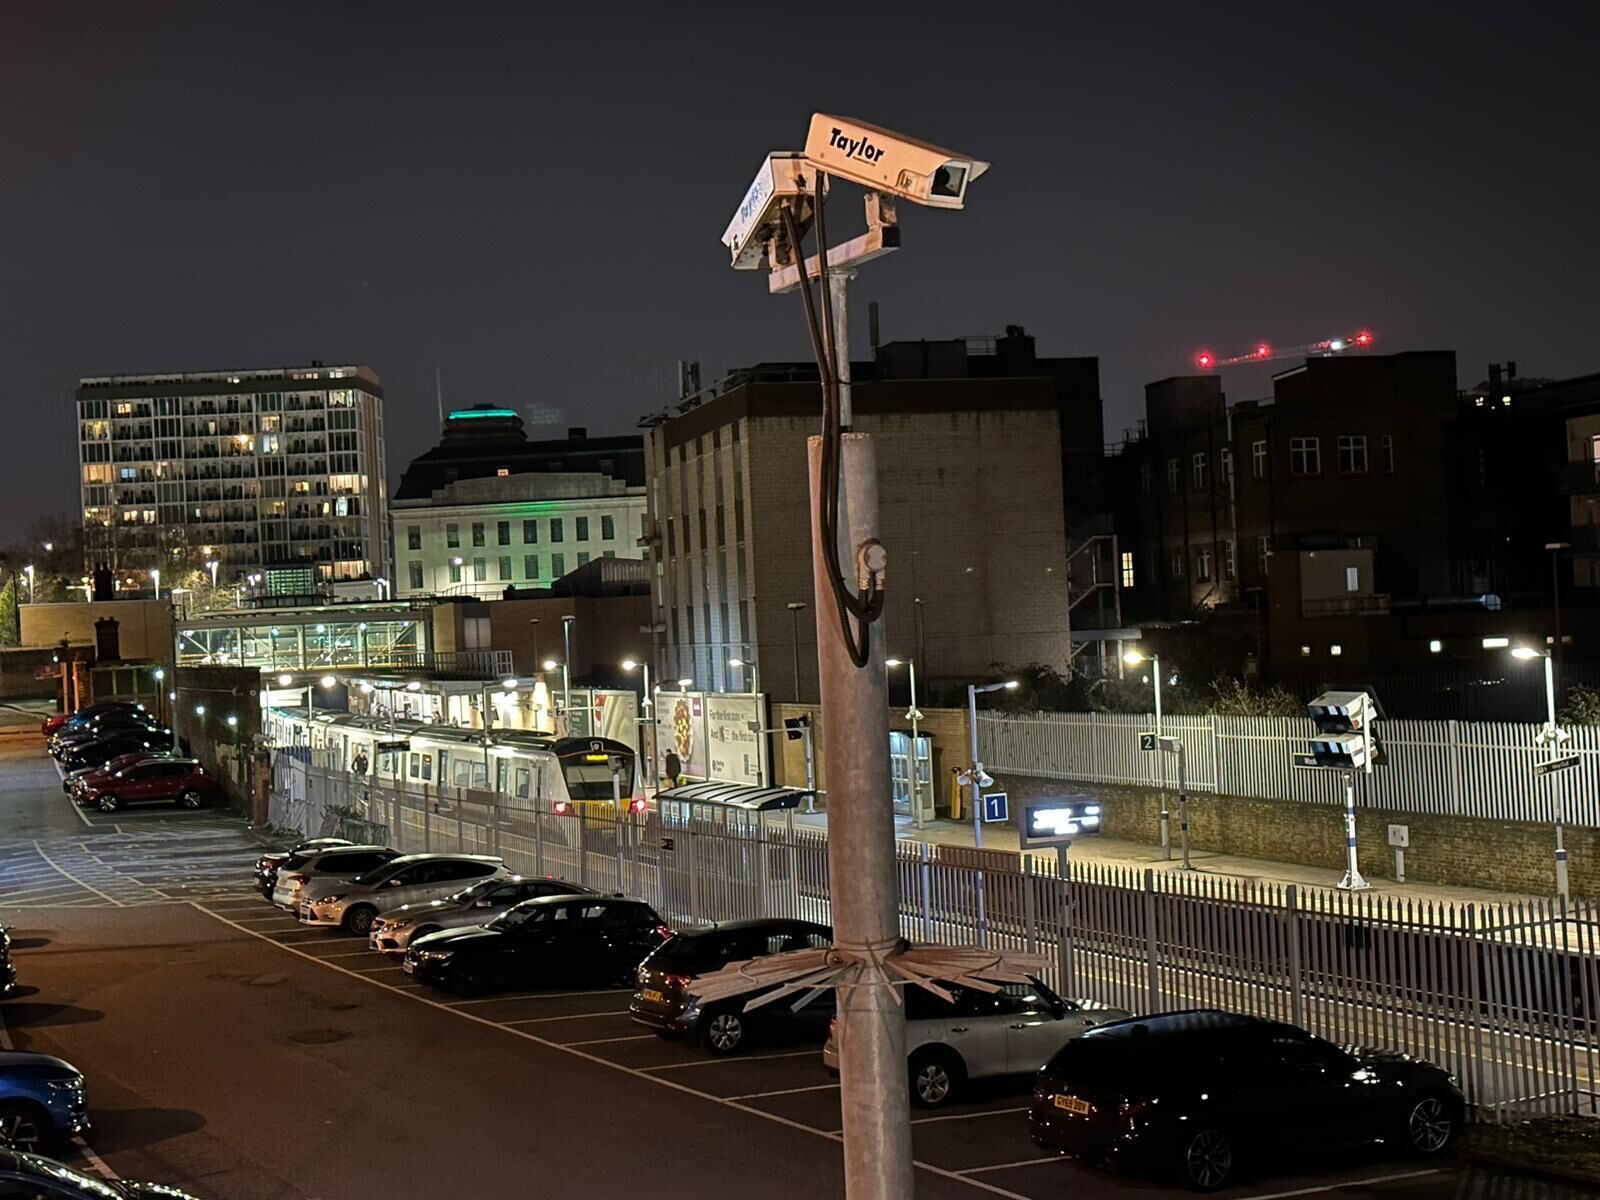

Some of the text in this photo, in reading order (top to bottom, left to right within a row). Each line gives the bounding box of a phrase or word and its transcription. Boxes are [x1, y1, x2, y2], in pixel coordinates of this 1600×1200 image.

[830, 127, 884, 162] Taylor
[1144, 736, 1152, 749] 2
[990, 799, 999, 817] 1
